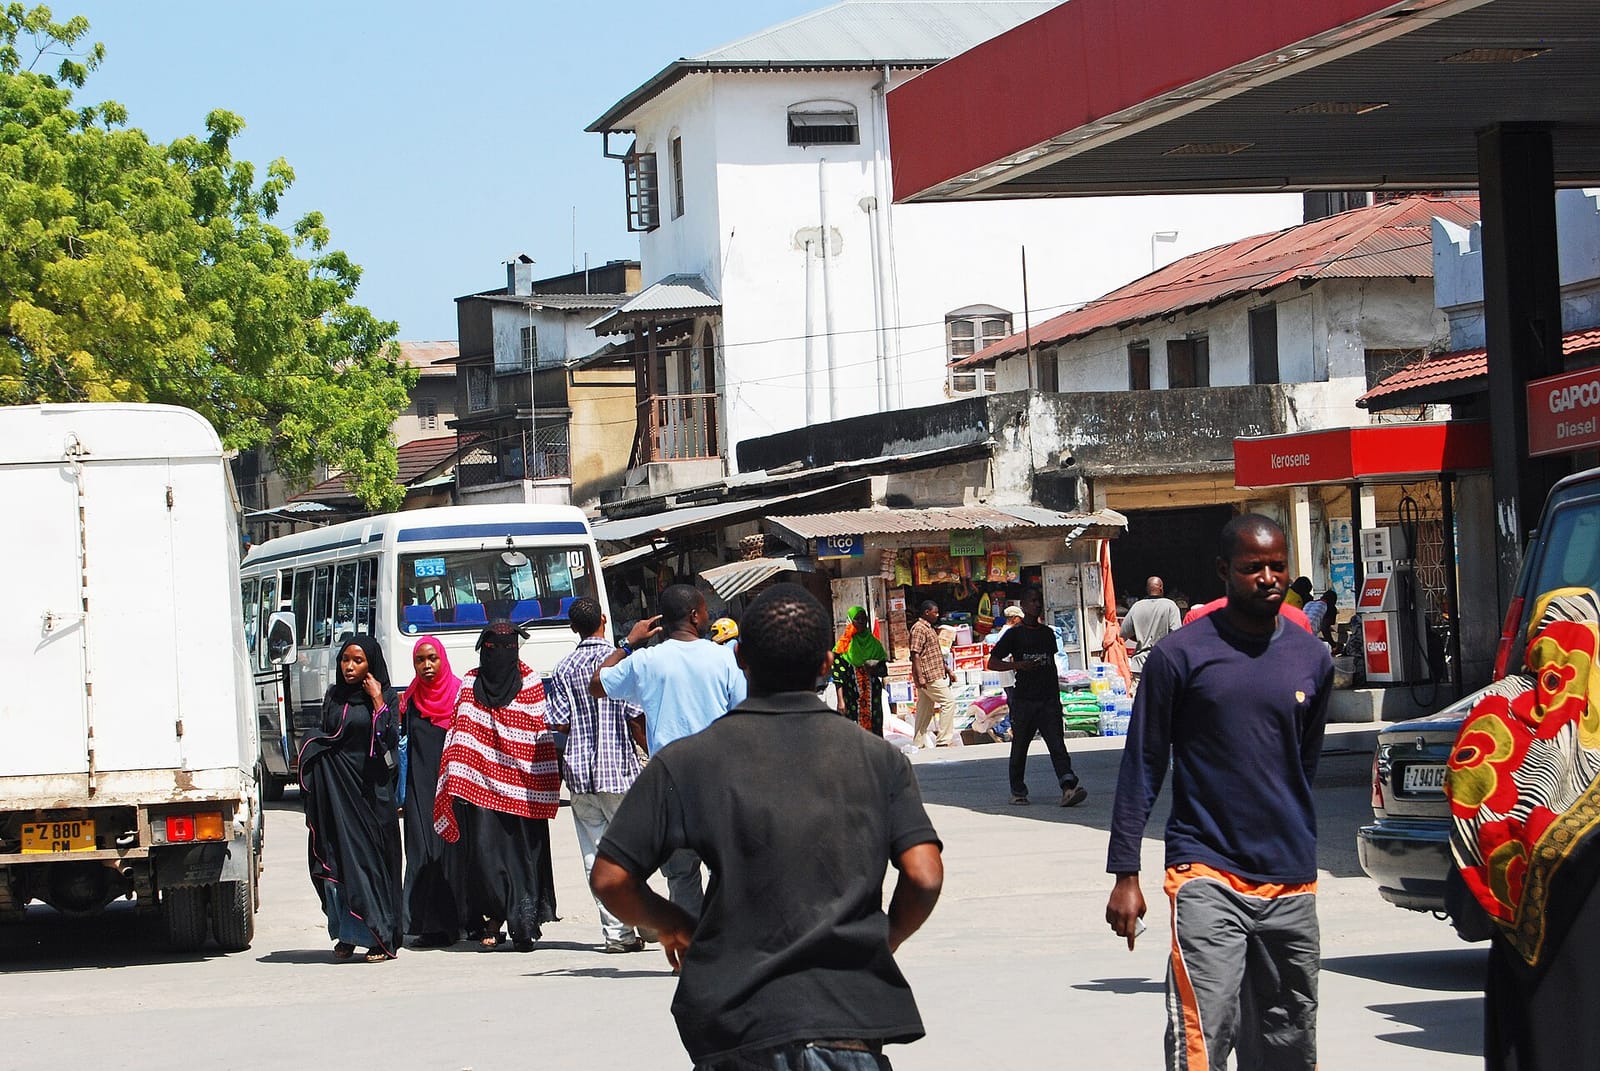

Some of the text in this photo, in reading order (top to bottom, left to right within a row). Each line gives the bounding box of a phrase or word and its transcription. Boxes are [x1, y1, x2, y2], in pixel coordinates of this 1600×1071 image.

[1549, 380, 1600, 413] GAPCO
[1557, 416, 1597, 439] Diesel
[1271, 453, 1310, 469] Kerosene
[416, 565, 444, 577] 335
[1366, 589, 1381, 597] GAPCO
[1367, 641, 1387, 652] GAPCO
[39, 822, 81, 839] Z 880
